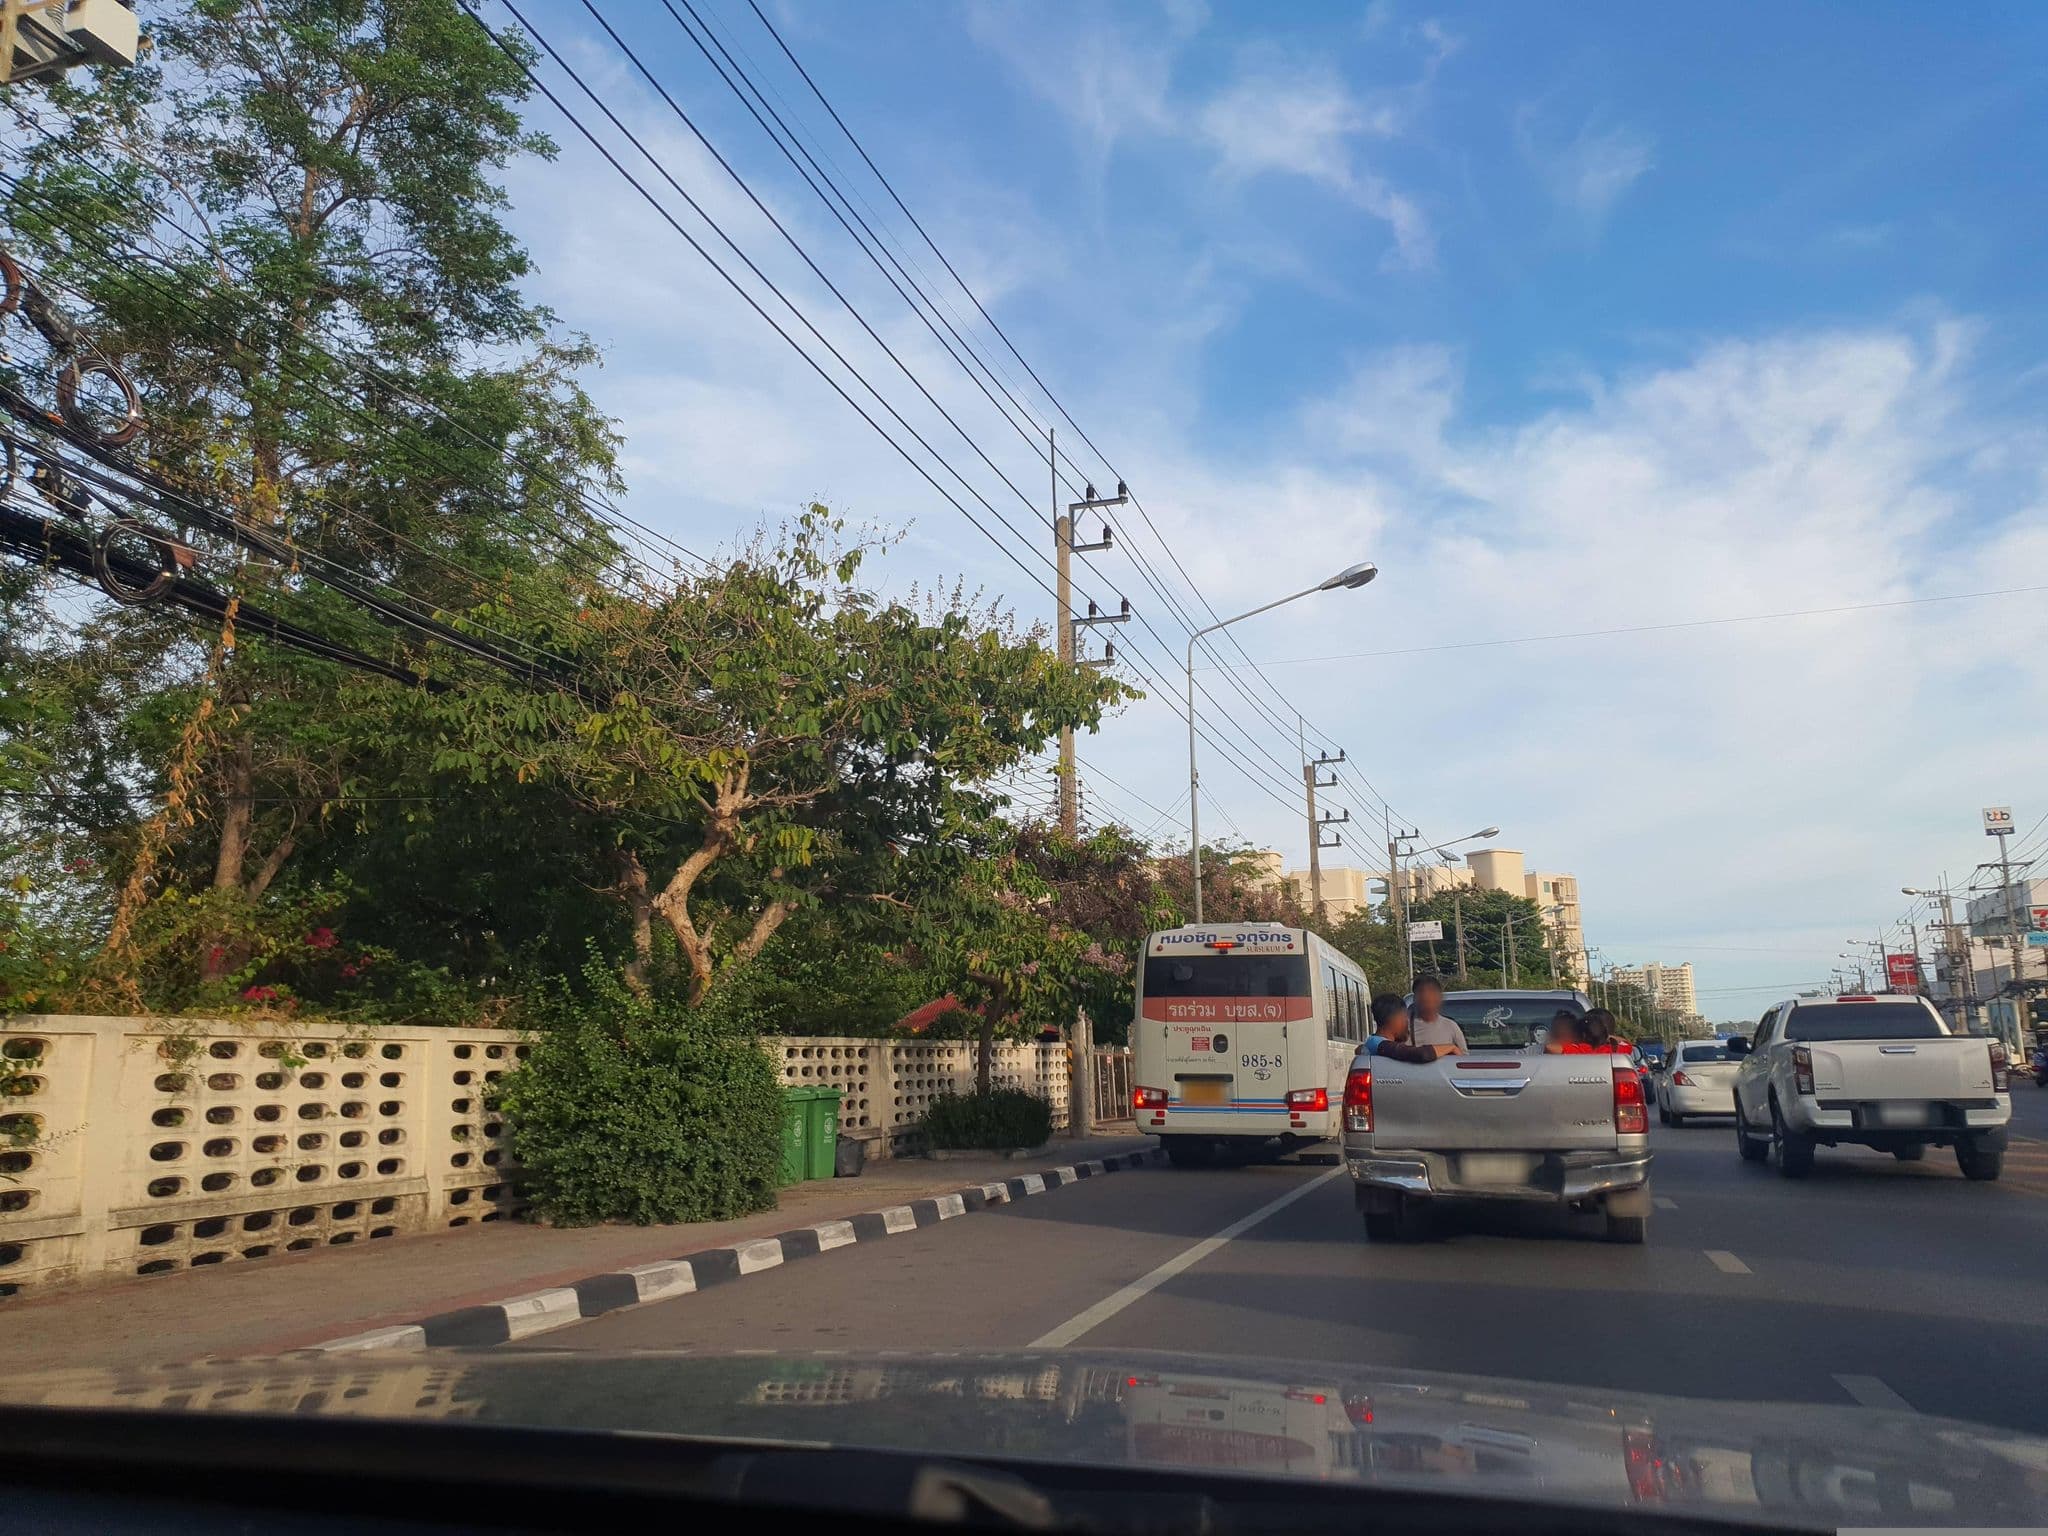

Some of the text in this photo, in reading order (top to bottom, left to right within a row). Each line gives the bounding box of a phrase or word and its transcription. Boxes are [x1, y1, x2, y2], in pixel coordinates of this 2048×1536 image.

[1986, 810, 2010, 821] ttb
[1235, 930, 1292, 945] จตุจักร
[1168, 1001, 1282, 1018] รถร่วม บขส.(จ)
[1241, 1054, 1283, 1068] 985-8
